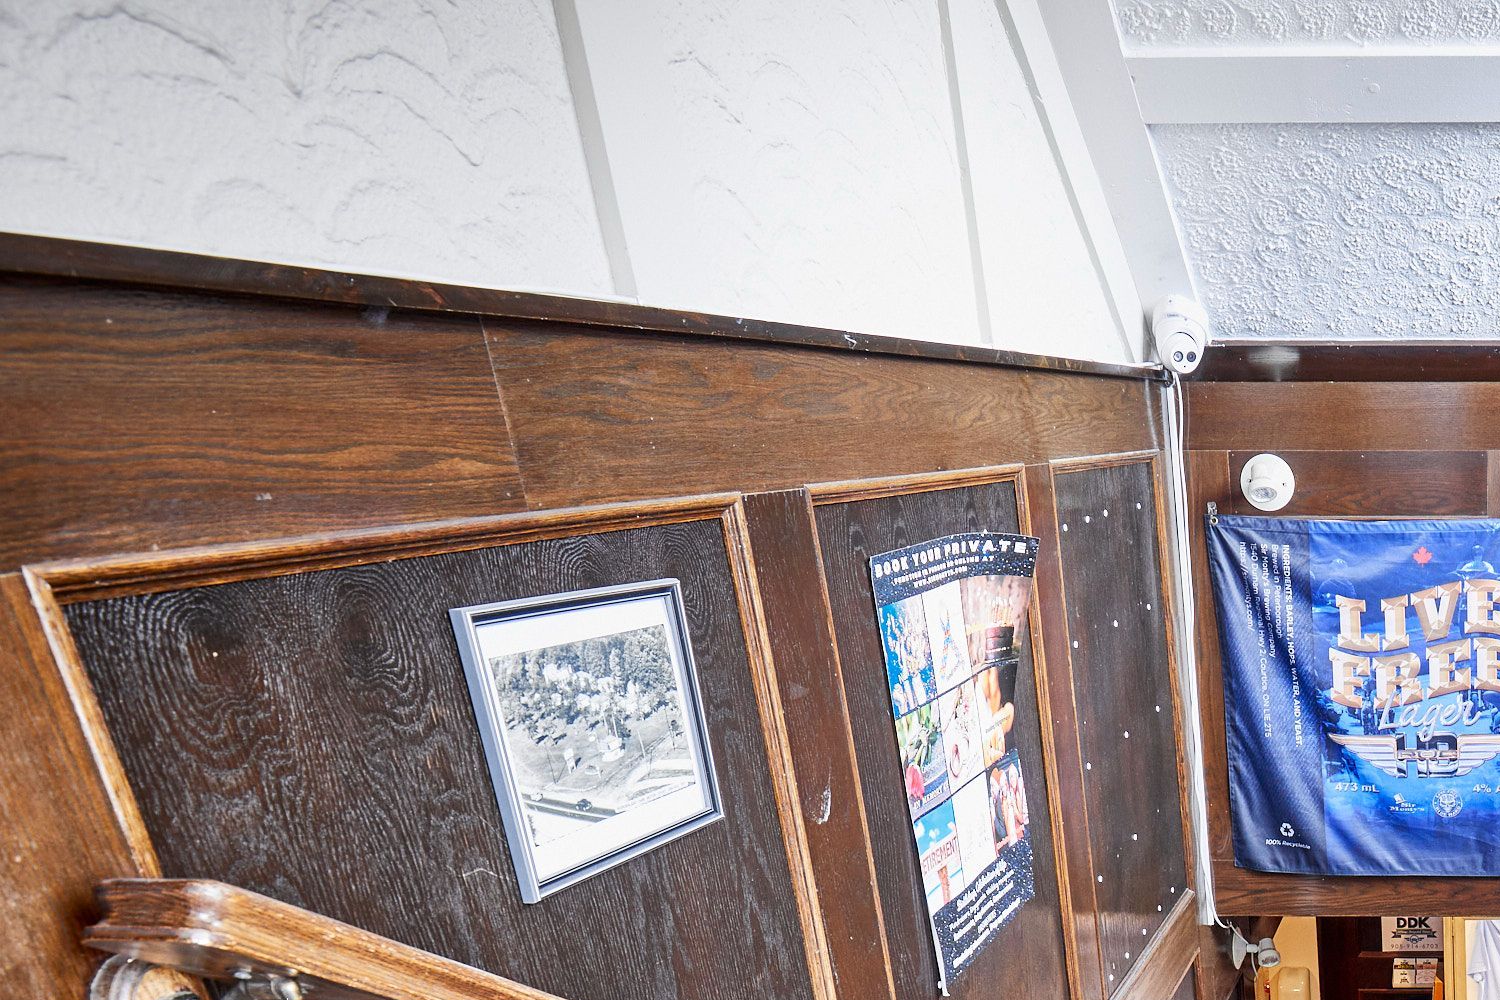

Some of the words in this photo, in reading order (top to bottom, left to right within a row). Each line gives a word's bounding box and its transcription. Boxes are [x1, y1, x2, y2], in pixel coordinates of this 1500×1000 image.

[874, 556, 909, 579] BOOK
[912, 547, 941, 567] YOUR
[944, 539, 1027, 557] PRIVATE
[954, 556, 980, 566] ONLINE
[1271, 544, 1280, 575] Brewed
[1262, 556, 1270, 587] Monty's
[1267, 622, 1276, 658] Company
[1274, 585, 1283, 639] Peterborough
[1251, 563, 1259, 595] Durham
[1263, 694, 1270, 707] ON
[1286, 604, 1294, 640] BARLEY,
[1293, 699, 1301, 717] AND
[1378, 689, 1481, 742] Lager
[1335, 782, 1358, 792] 473
[1361, 784, 1380, 794] mL
[1473, 784, 1492, 793] 4%
[1282, 840, 1311, 850] Recyclable
[1396, 917, 1430, 928] DDK
